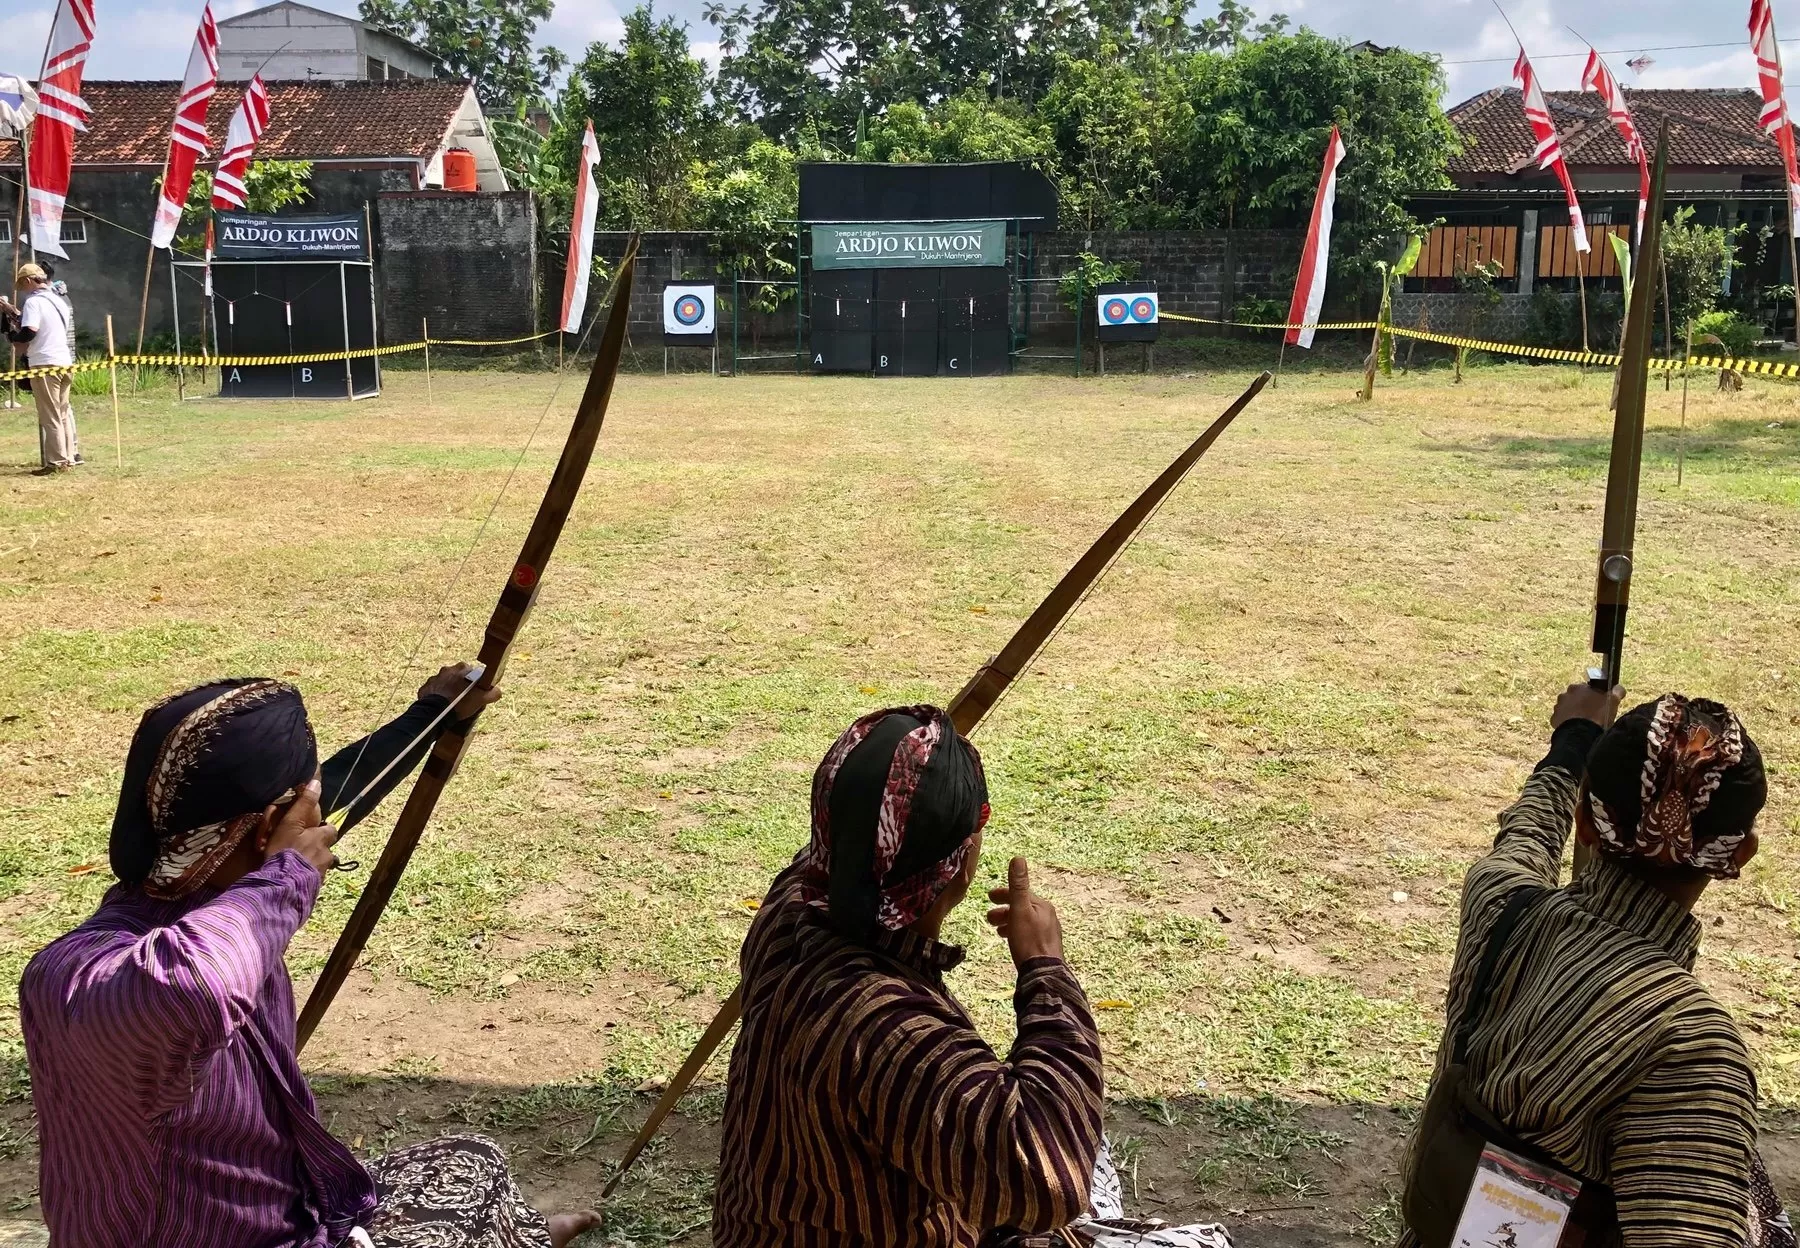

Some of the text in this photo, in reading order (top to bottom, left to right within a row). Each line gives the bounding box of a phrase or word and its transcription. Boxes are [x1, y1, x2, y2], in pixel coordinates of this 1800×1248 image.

[220, 216, 268, 226] Jemparingan
[222, 227, 359, 243] ARDJO KLIWON
[835, 230, 880, 238] Jemparingan
[835, 235, 981, 255] ARDJO KLIWON
[814, 353, 823, 364] A
[880, 355, 888, 367] B
[950, 358, 958, 369] C
[229, 368, 241, 383] A
[302, 368, 313, 383] B
